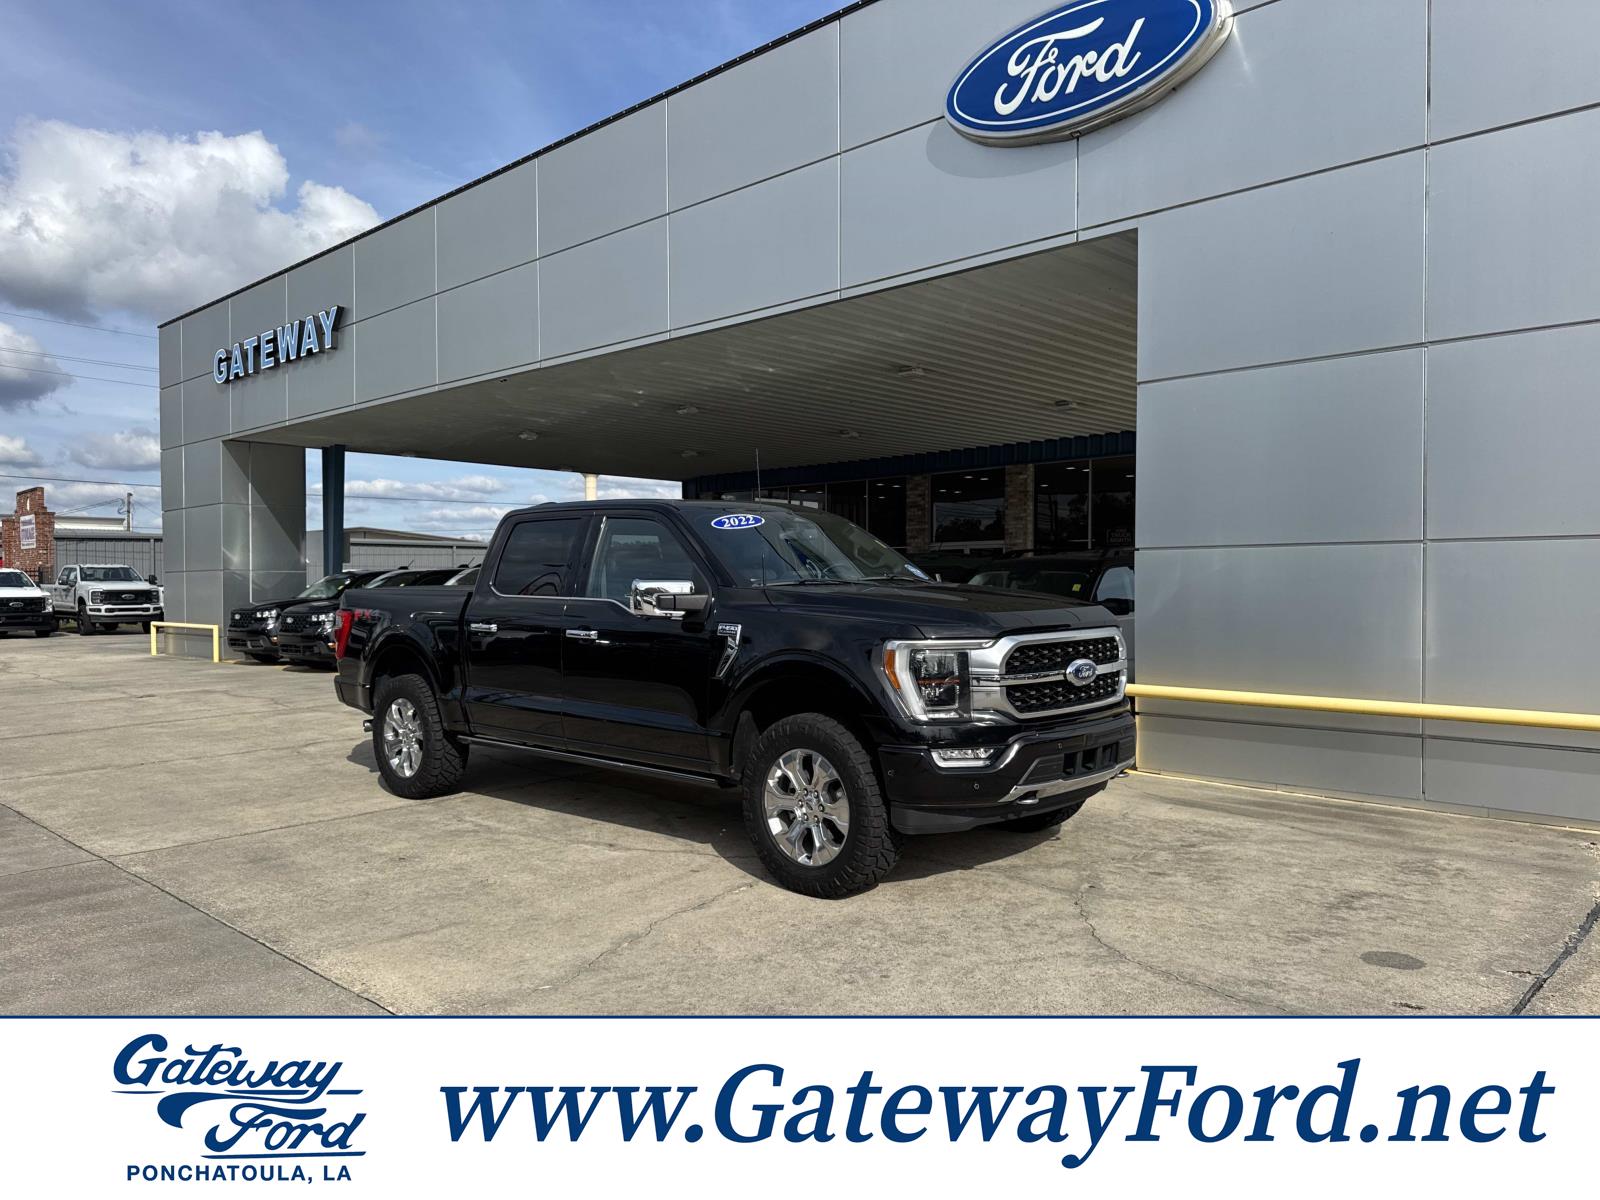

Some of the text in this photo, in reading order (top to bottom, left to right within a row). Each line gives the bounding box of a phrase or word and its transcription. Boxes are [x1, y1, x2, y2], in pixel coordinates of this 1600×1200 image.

[993, 16, 1145, 115] Ford
[213, 305, 340, 384] GATEWAY
[722, 516, 755, 527] 2022
